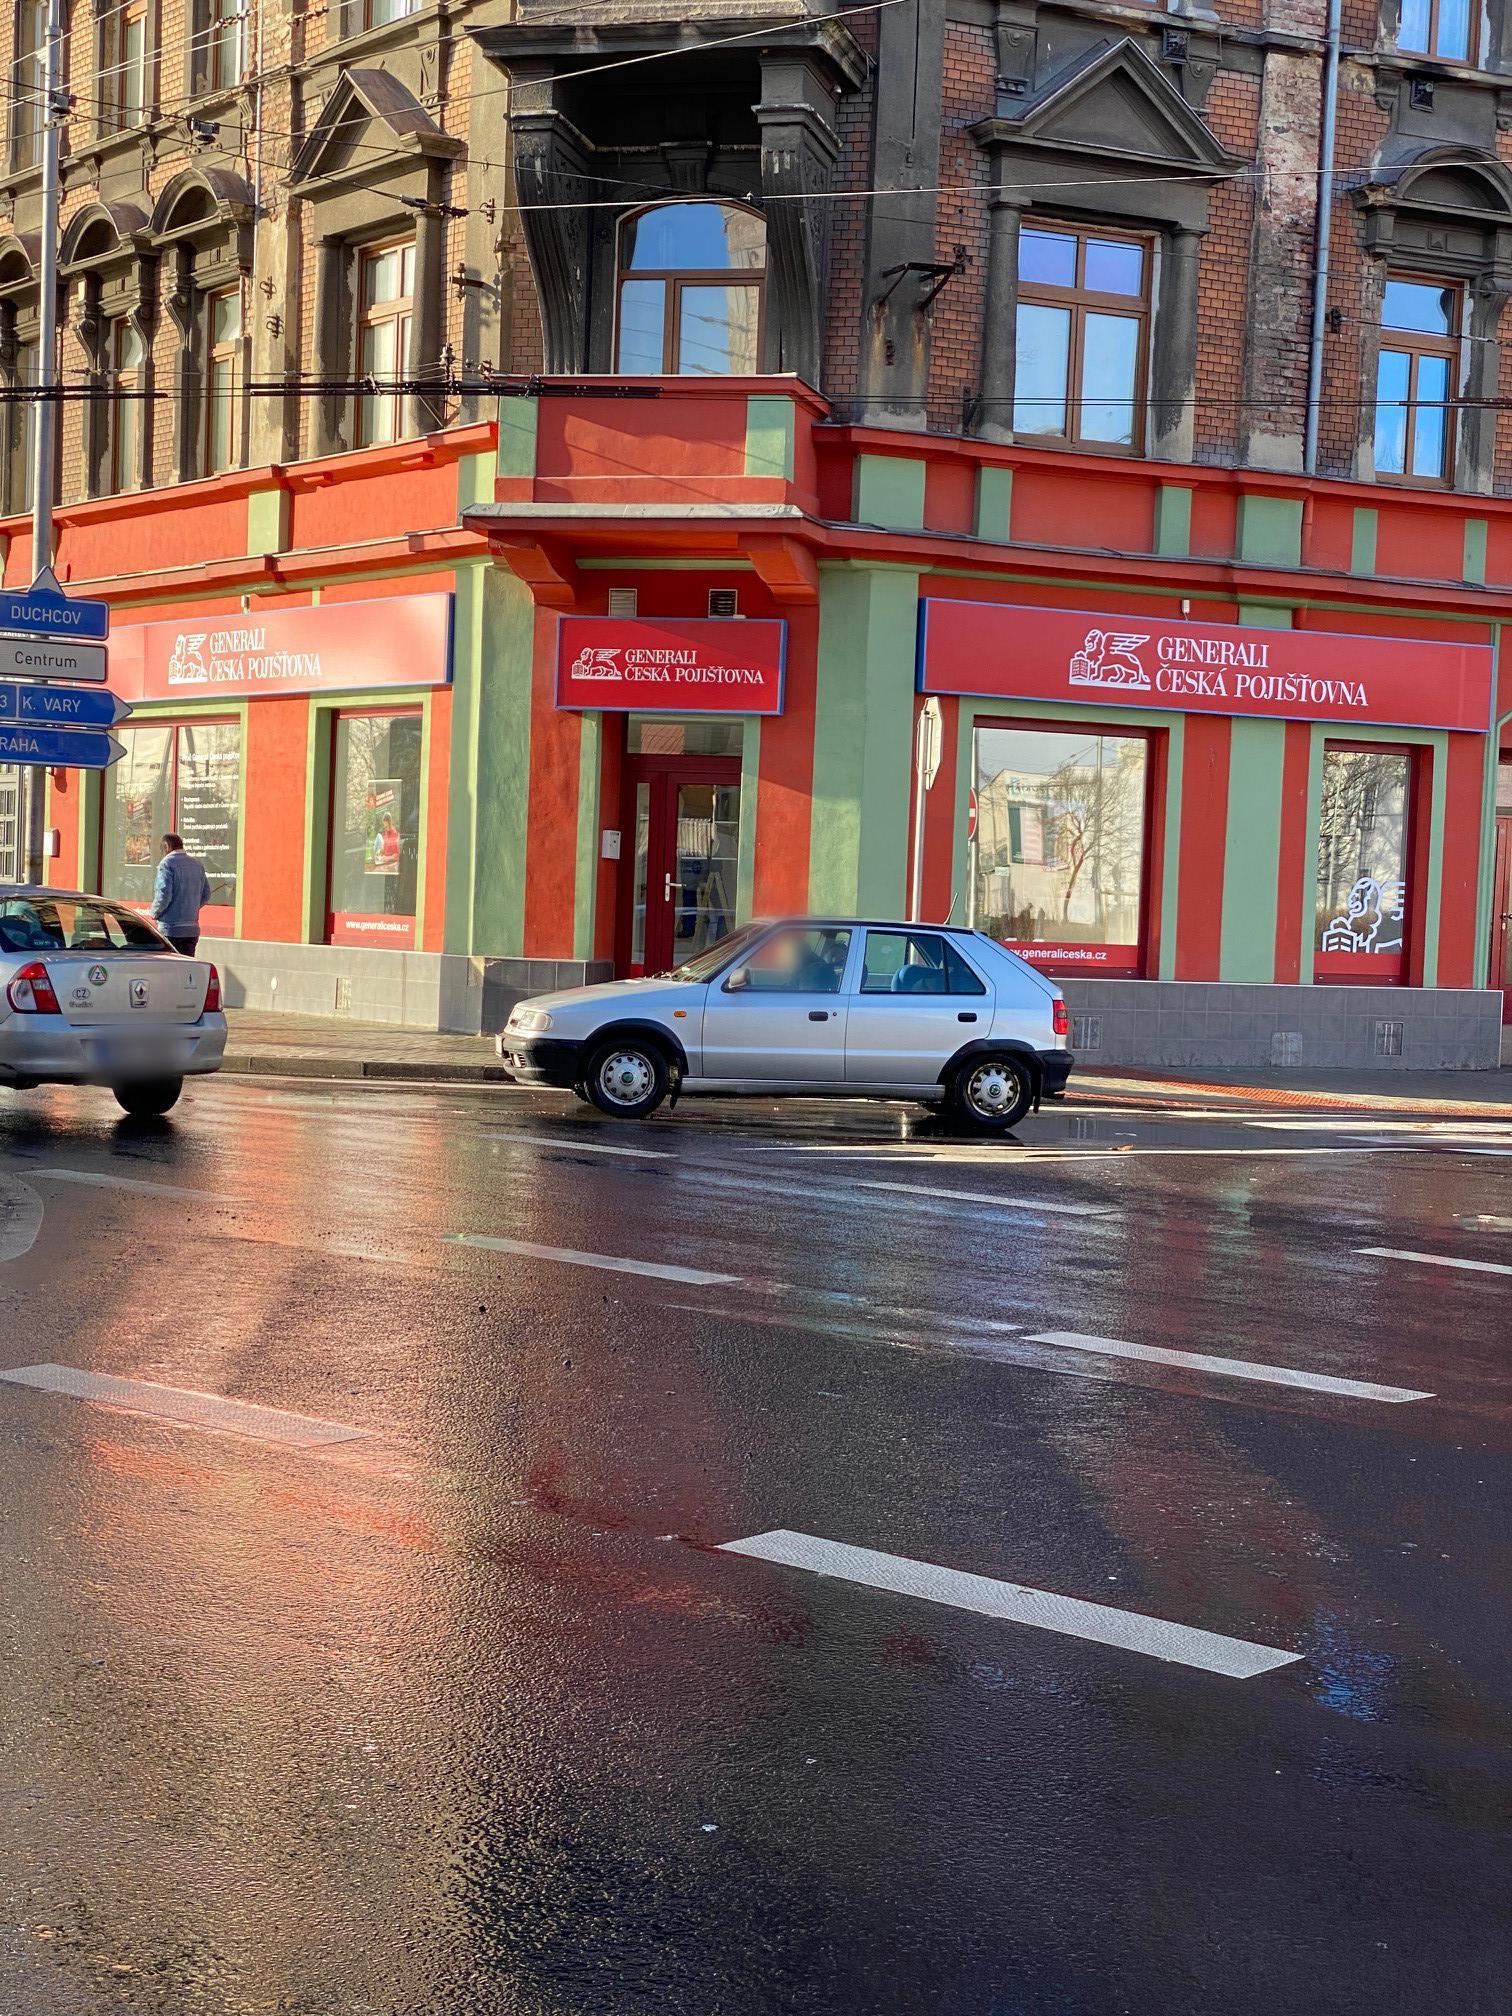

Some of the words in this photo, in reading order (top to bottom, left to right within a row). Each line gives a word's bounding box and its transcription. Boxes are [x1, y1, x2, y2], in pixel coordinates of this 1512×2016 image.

[11, 606, 82, 625] DUCHCOV
[209, 628, 266, 654] GENERALI
[15, 651, 77, 668] Centrum
[625, 649, 697, 664] GENERALI
[1157, 636, 1269, 668] GENERALI
[208, 654, 245, 682] ČESKÁ
[248, 651, 322, 680] POJIŠŤOVNA
[624, 664, 671, 682] ČESKÁ
[675, 665, 765, 684] POJIŠŤOVNA
[1155, 663, 1227, 697] ČESKÁ
[1235, 672, 1369, 706] POJIŠŤOVNA
[22, 696, 36, 710] K.
[43, 698, 81, 713] VARY
[1010, 948, 1107, 960] w.generaliceska.cz
[76, 989, 87, 998] CZ
